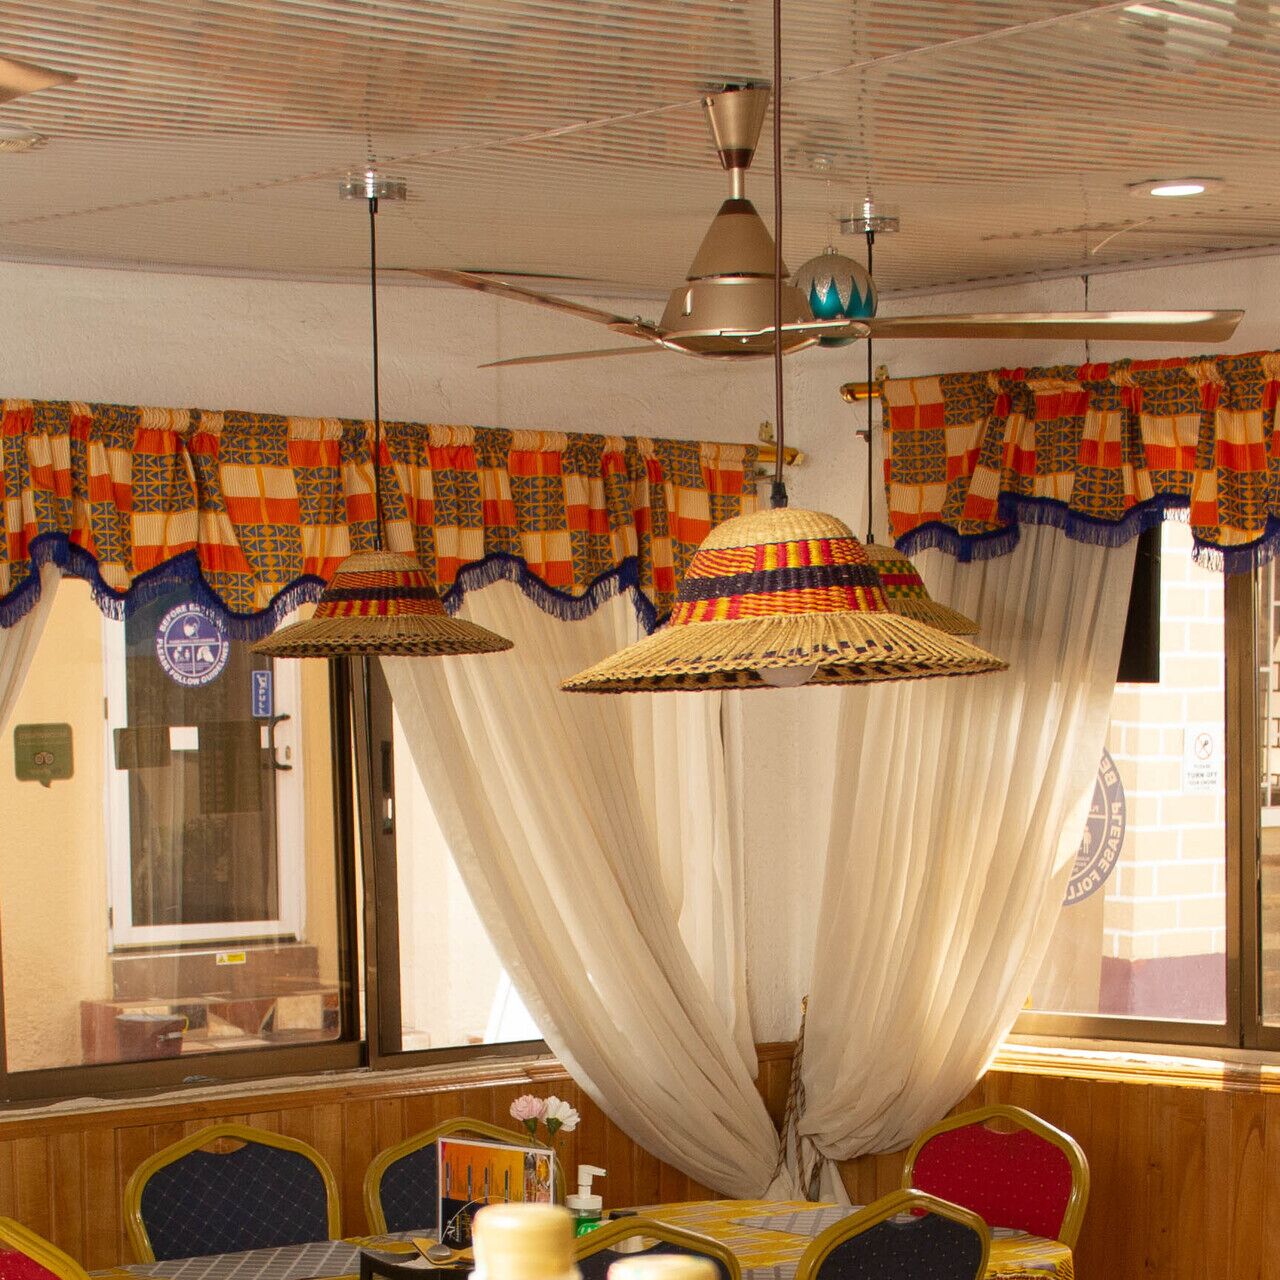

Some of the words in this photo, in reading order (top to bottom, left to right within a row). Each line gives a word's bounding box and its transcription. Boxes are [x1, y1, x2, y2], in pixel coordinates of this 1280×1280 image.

[159, 603, 188, 632] BEFORE
[156, 638, 171, 672] PLEASE
[168, 668, 201, 686] FOLLOW
[200, 641, 230, 685] GUIDELINES
